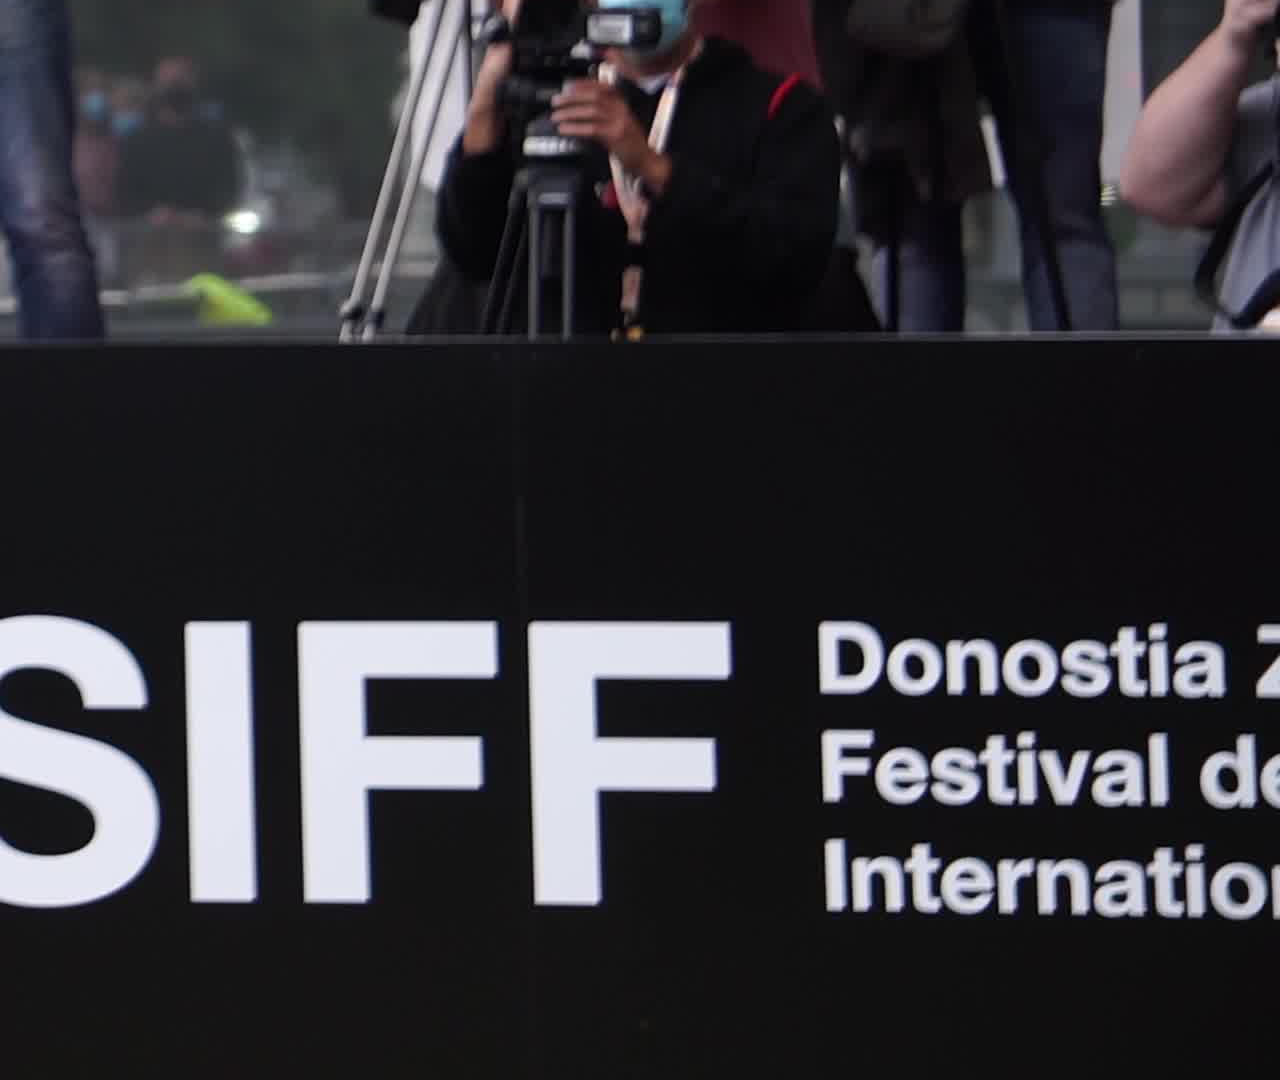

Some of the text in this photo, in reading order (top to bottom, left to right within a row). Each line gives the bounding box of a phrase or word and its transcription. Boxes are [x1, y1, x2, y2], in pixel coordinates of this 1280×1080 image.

[818, 621, 1226, 698] Donostia
[821, 729, 1169, 807] Festival
[824, 838, 1280, 919] Internatio
